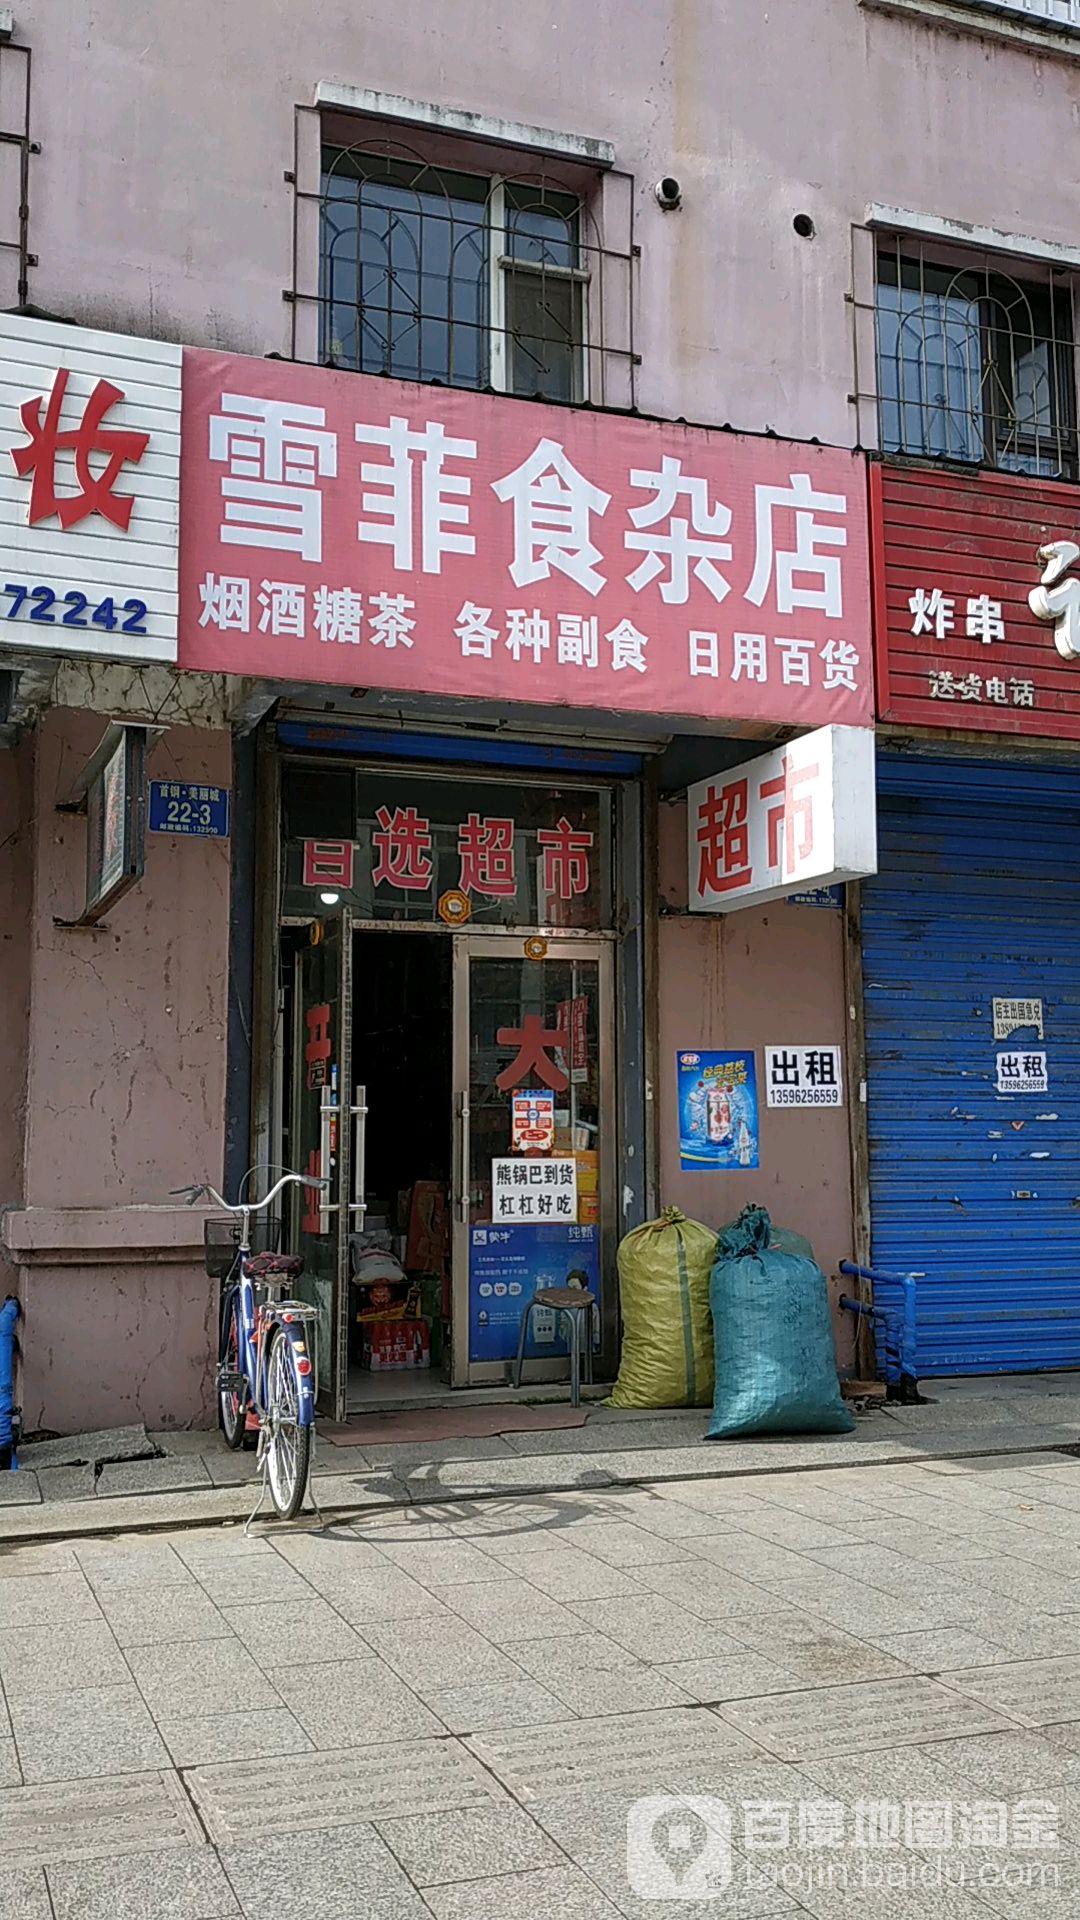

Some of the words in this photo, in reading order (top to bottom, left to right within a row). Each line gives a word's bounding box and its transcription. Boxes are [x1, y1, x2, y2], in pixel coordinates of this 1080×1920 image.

[9, 367, 151, 533] 妆
[208, 391, 848, 619] 雪菲食杂店
[4, 583, 148, 633] 72242
[198, 572, 417, 648] 烟酒糖茶
[908, 587, 1006, 644] 炸串
[452, 601, 649, 673] 各种副食
[688, 630, 860, 691] 日用百货
[928, 670, 1035, 707] 送货电话
[167, 800, 212, 825] 22-3
[696, 753, 820, 898] 超市
[495, 1014, 570, 1092] 大
[771, 1050, 837, 1087] 出租
[1000, 1054, 1045, 1078] 出租
[770, 1089, 839, 1104] 13596256559
[1000, 1079, 1045, 1090] 13596256559
[496, 1163, 574, 1186] 熊锅巴到货
[499, 1194, 572, 1216] 杠杠好吃
